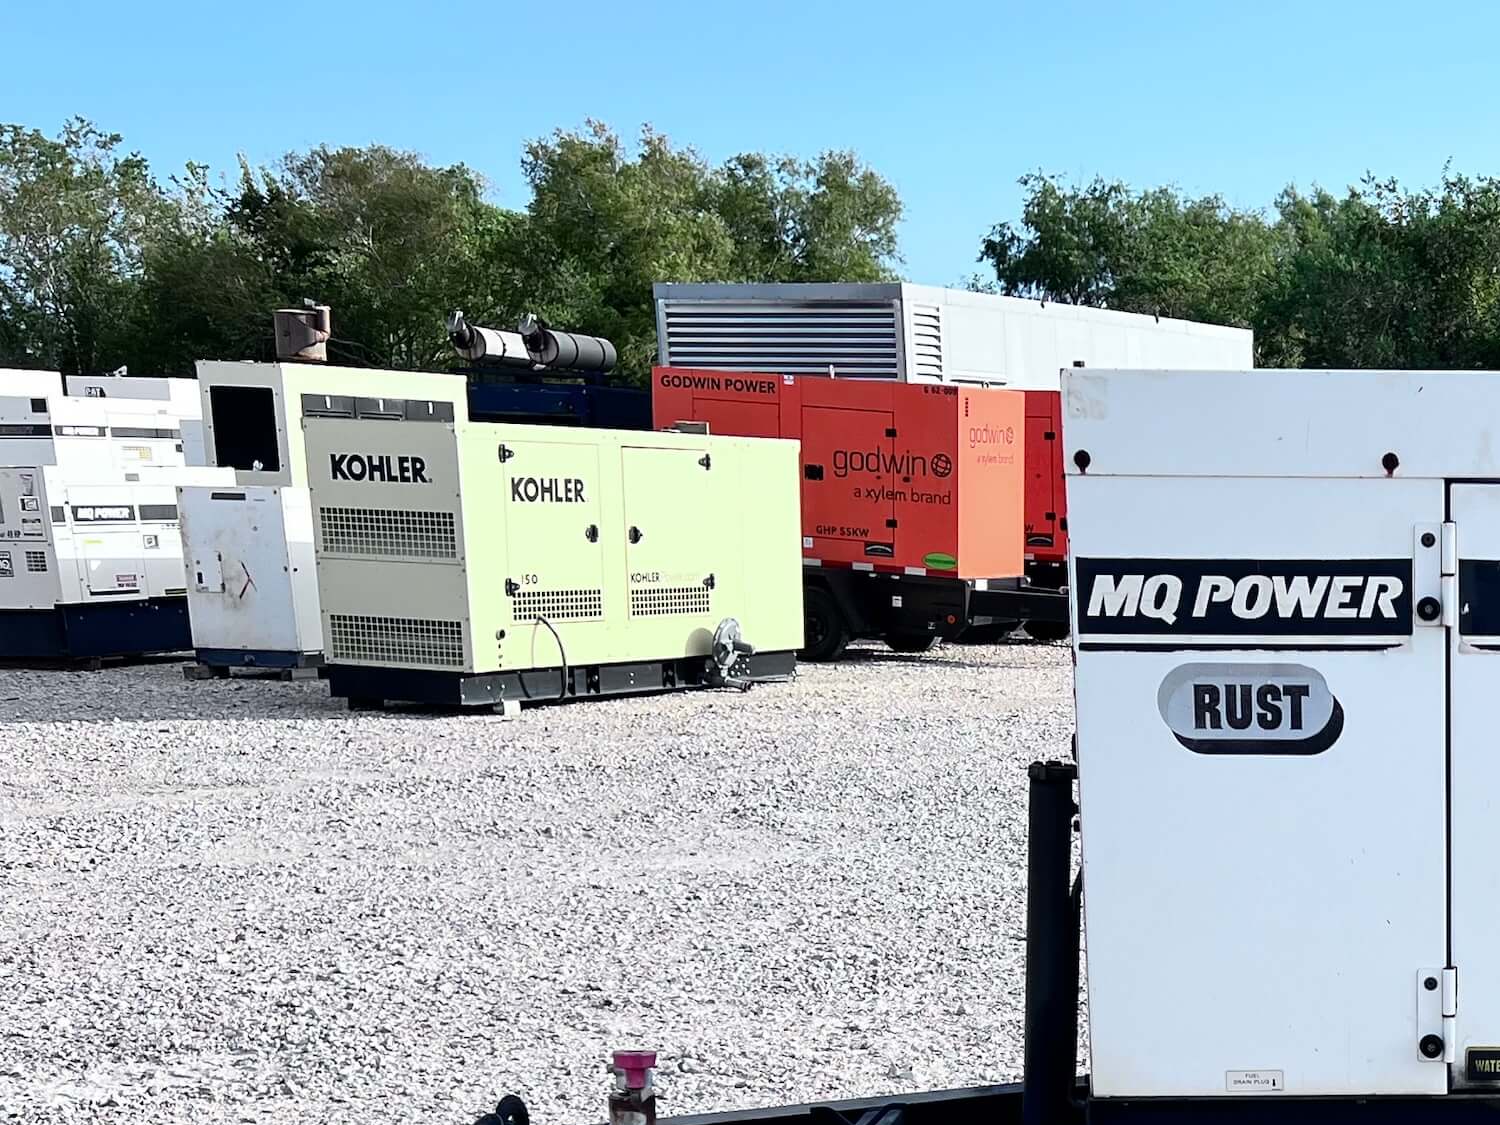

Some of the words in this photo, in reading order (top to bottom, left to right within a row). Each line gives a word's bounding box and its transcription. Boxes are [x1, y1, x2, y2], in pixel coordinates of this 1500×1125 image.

[660, 374, 720, 390] GODWIN
[725, 378, 776, 394] POWER
[969, 424, 1004, 448] godwin
[329, 453, 428, 483] KOHLER
[832, 445, 927, 479] godwin
[511, 477, 585, 502] KOHLER
[854, 487, 862, 498] a
[866, 485, 907, 504] xylem
[911, 487, 951, 505] brand
[816, 524, 837, 536] GHP
[1087, 574, 1182, 625] MQ
[1192, 575, 1403, 619] POWER
[1193, 683, 1309, 730] RUST
